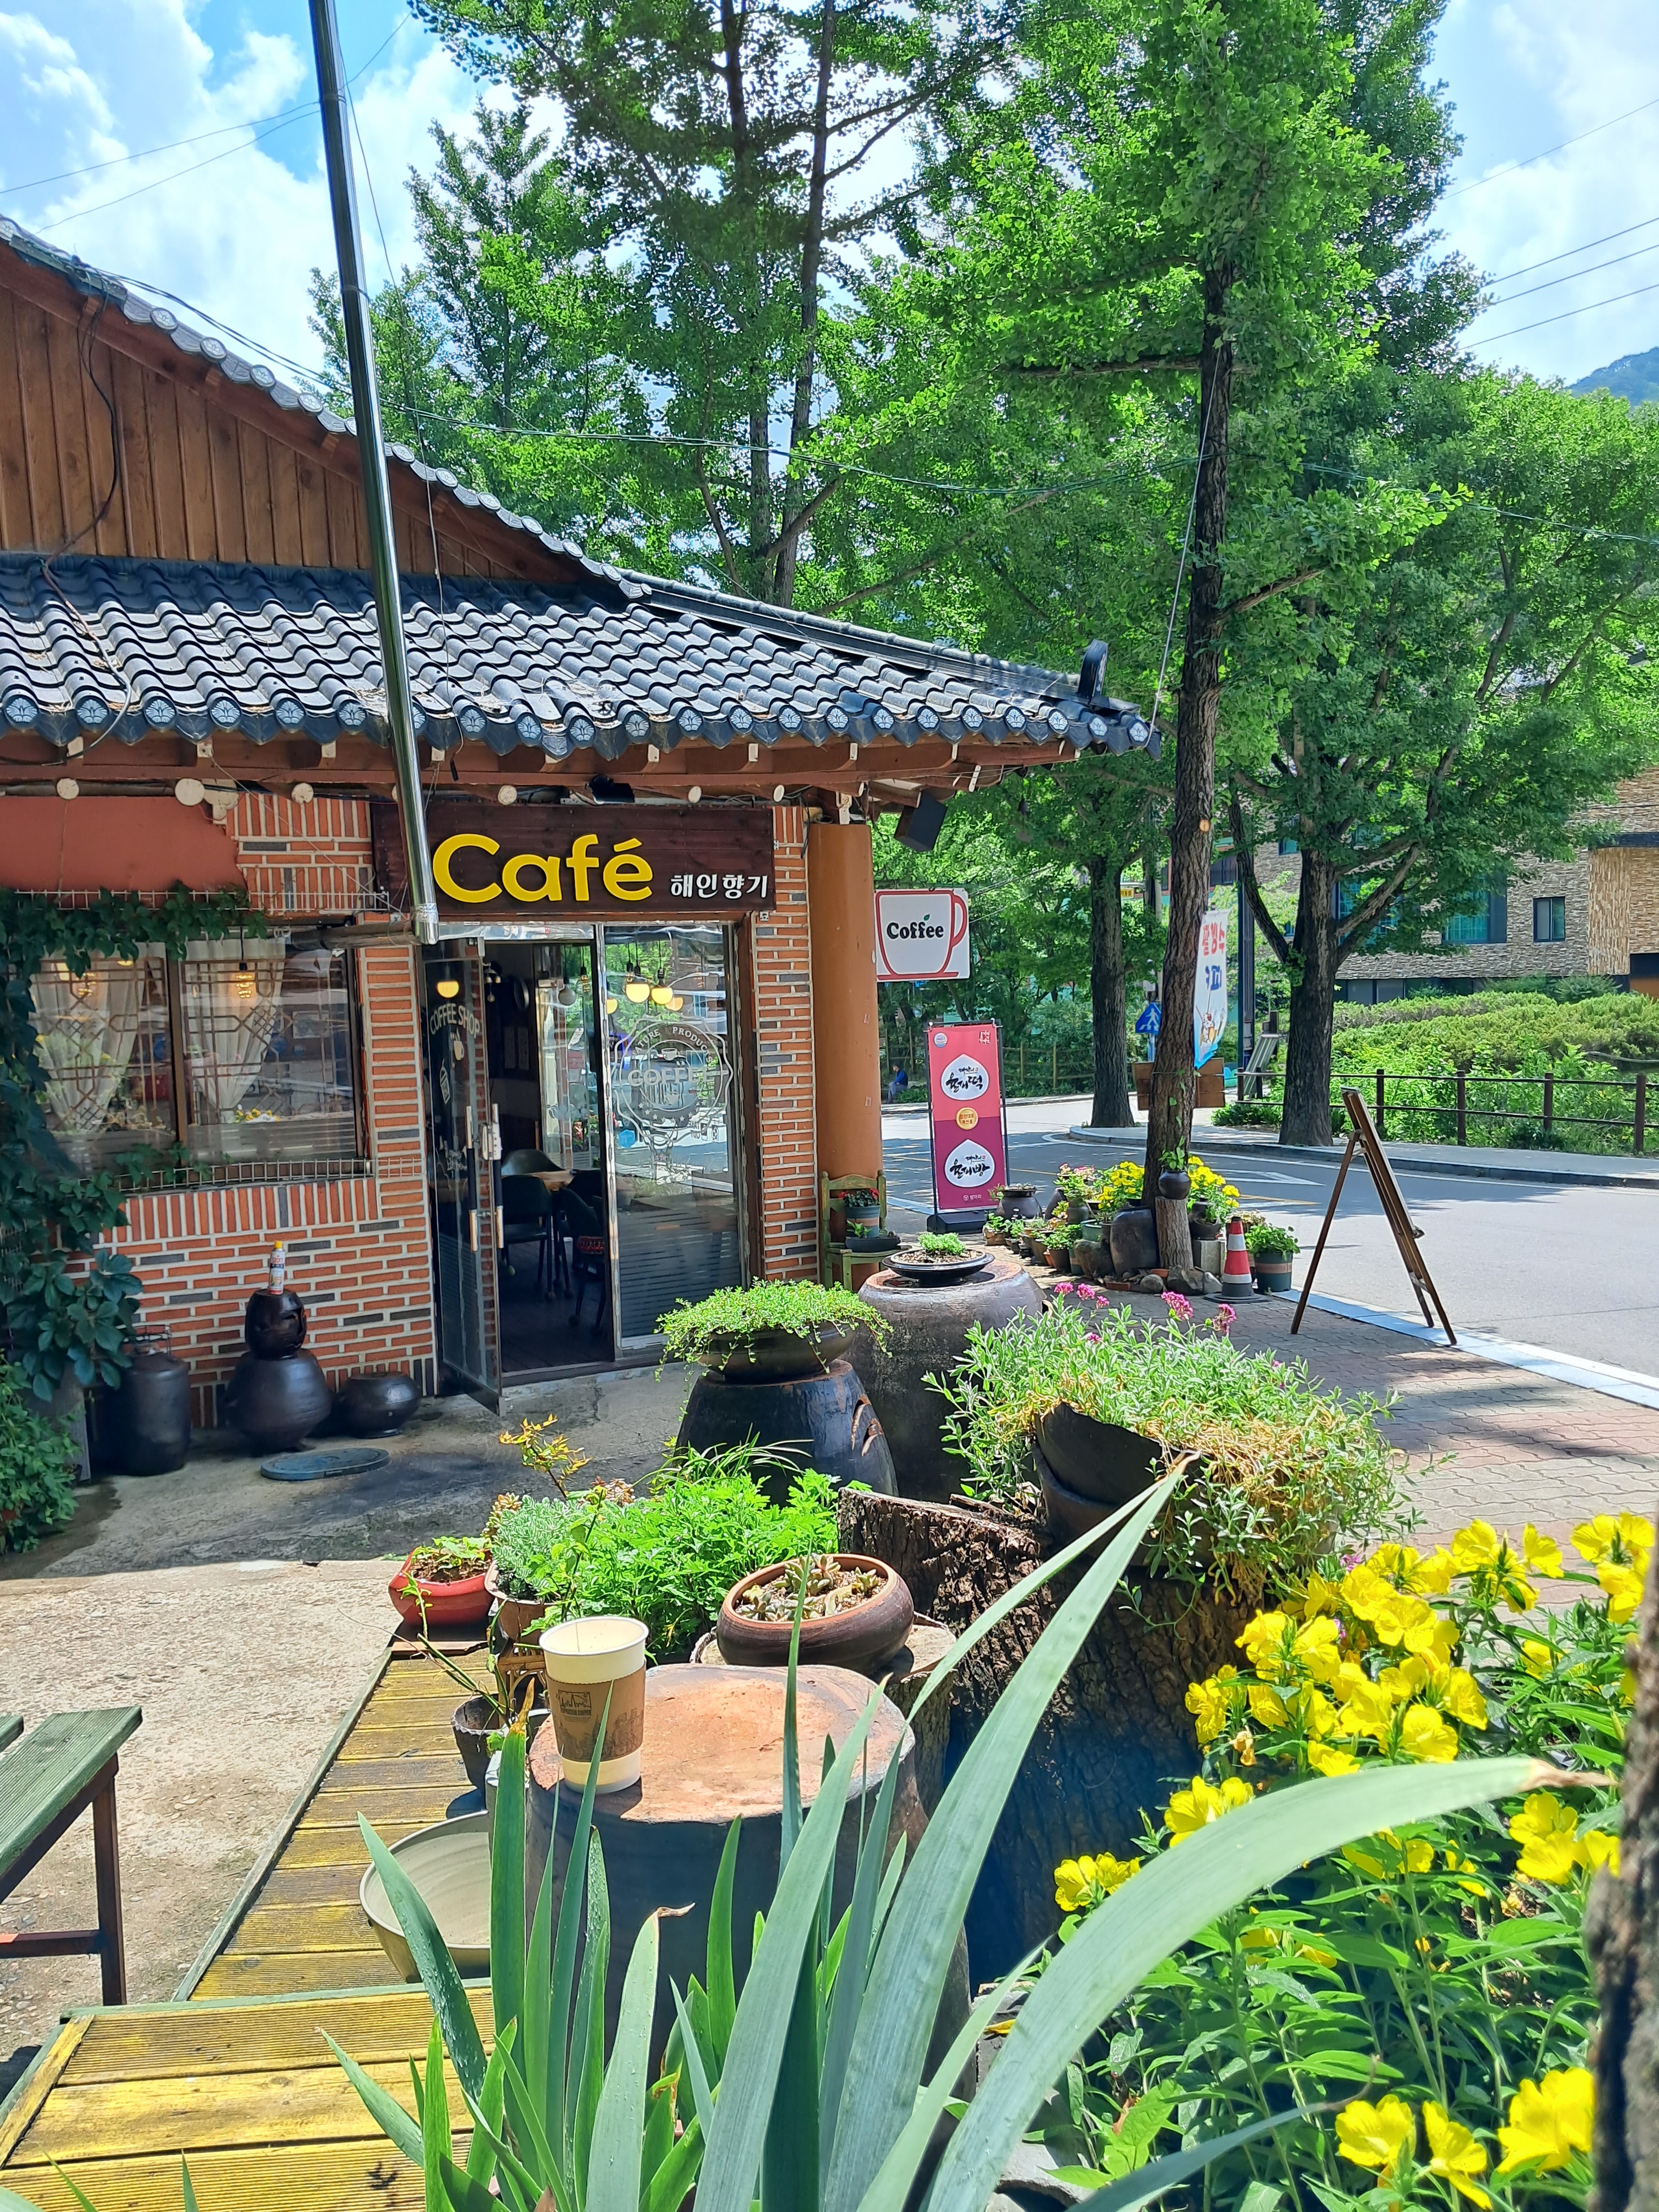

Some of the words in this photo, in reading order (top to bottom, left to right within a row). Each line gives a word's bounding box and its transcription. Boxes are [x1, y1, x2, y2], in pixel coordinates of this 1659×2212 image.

[433, 833, 653, 903] Café
[670, 874, 768, 900] 해인향기
[886, 922, 944, 939] Coffee
[429, 1002, 457, 1036] COFFEE
[458, 1005, 480, 1039] SHOP
[672, 1026, 713, 1064] PRODUCTS
